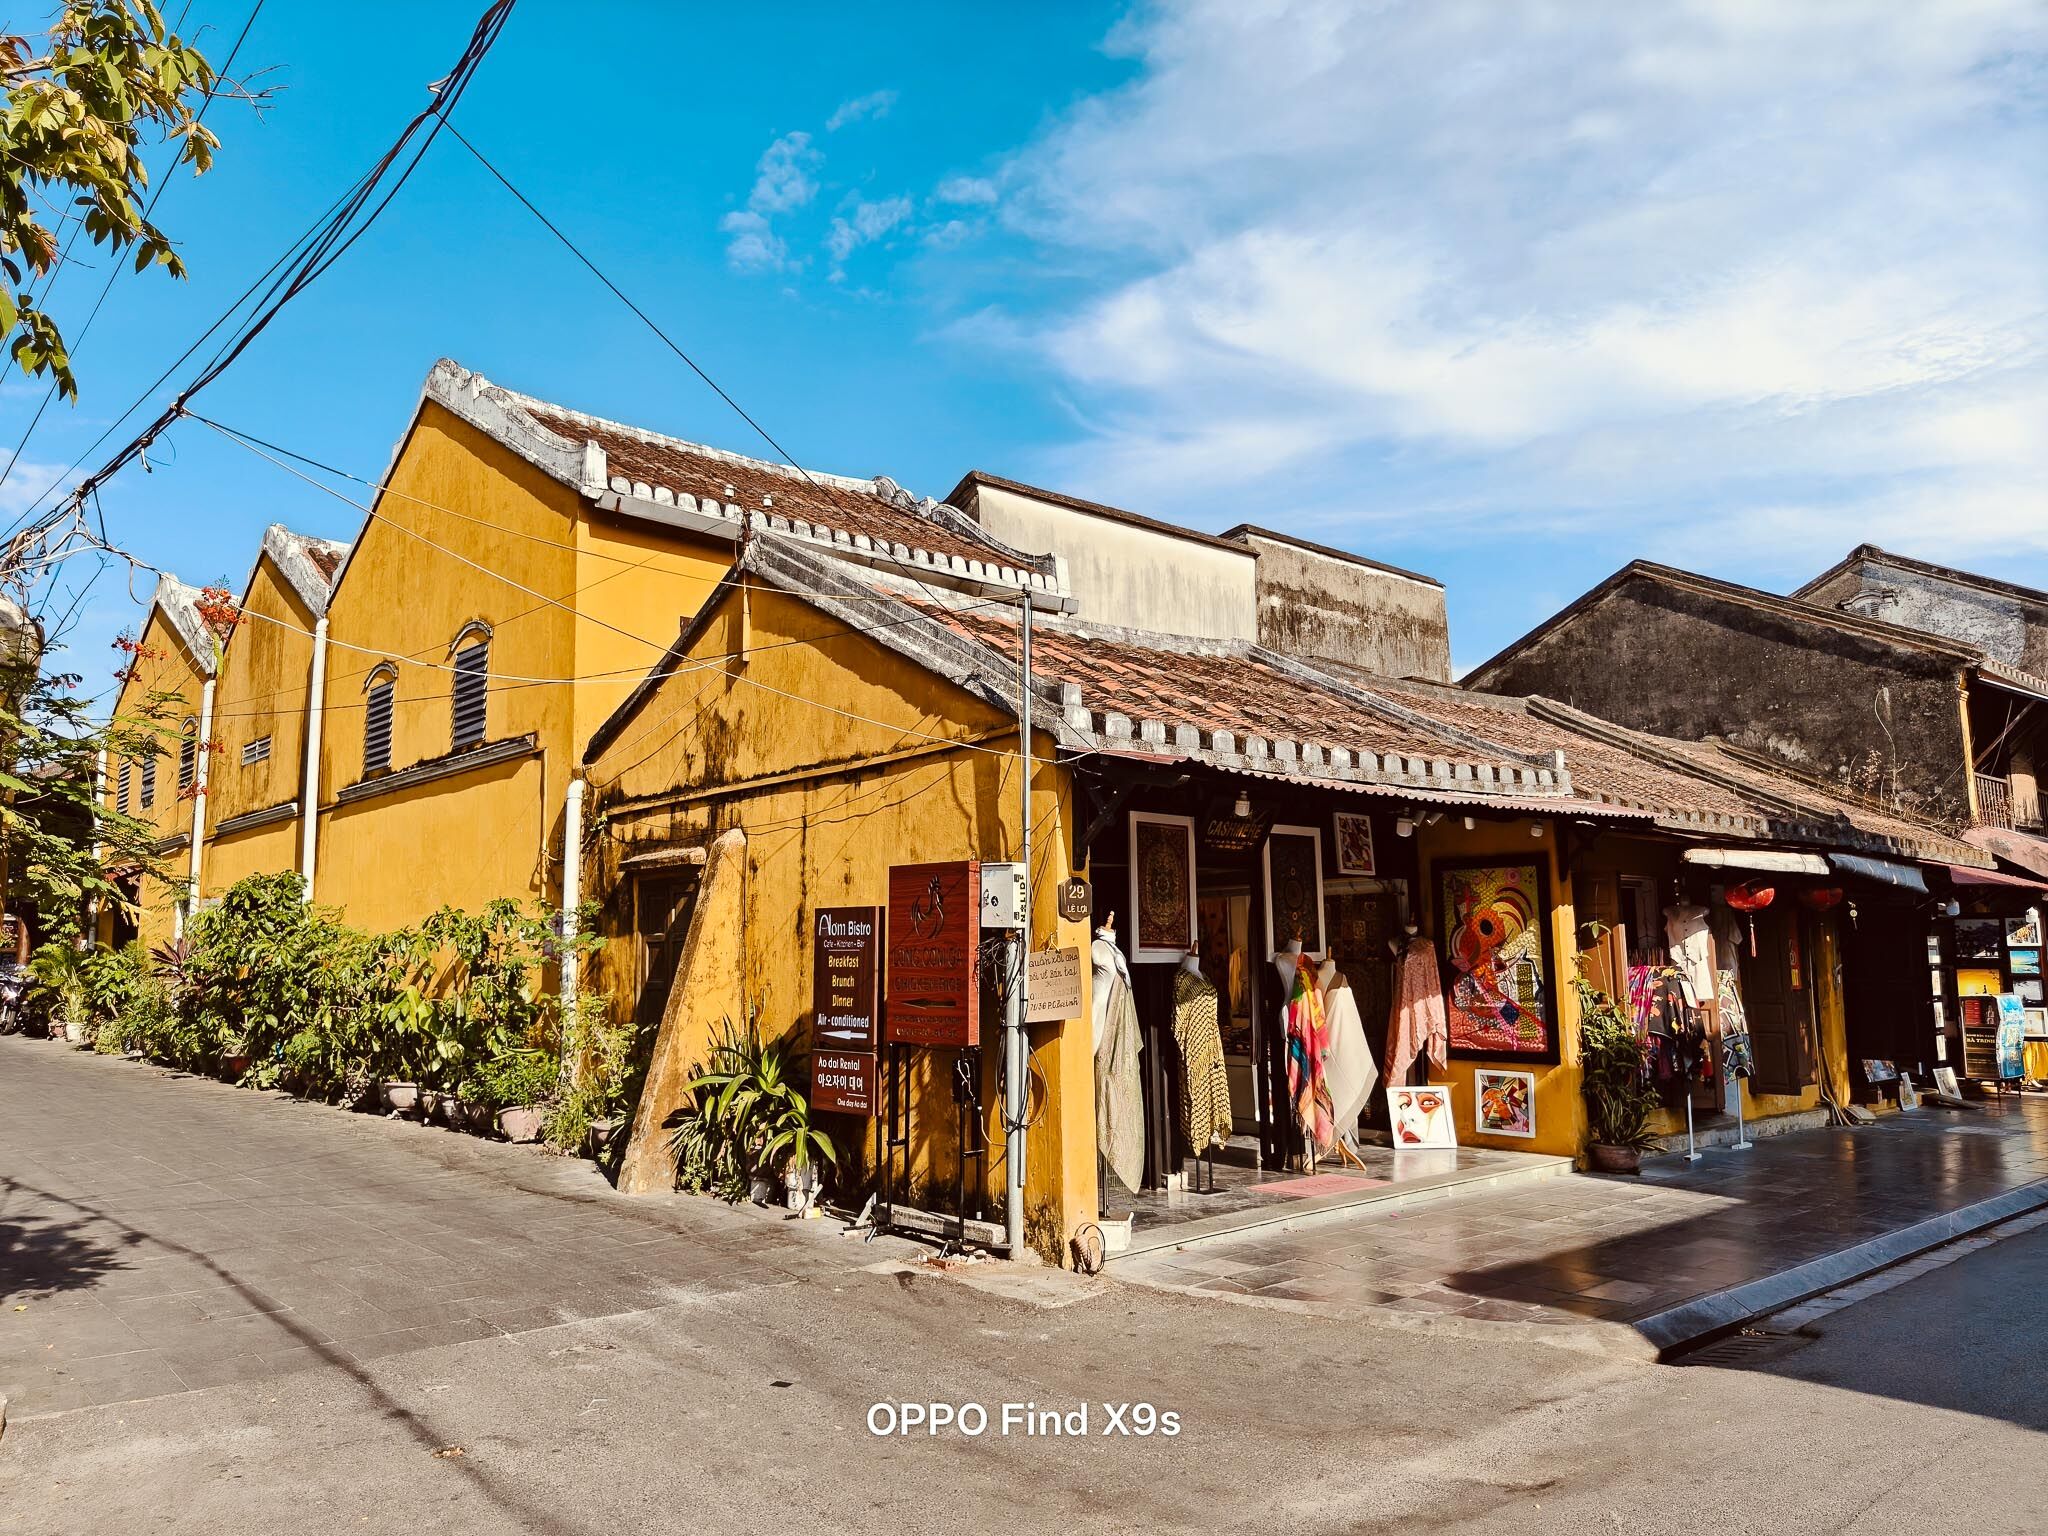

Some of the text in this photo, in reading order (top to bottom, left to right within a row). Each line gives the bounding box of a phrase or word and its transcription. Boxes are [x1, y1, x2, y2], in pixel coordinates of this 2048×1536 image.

[1069, 884, 1085, 899] 29
[1067, 904, 1076, 913] LÊ
[848, 920, 871, 936] Bistro
[828, 955, 859, 968] Breakfast
[832, 974, 855, 987] Brunch
[832, 994, 854, 1007] Dinner
[840, 1057, 860, 1071] Rental
[817, 1072, 863, 1092] 아오자이 대여
